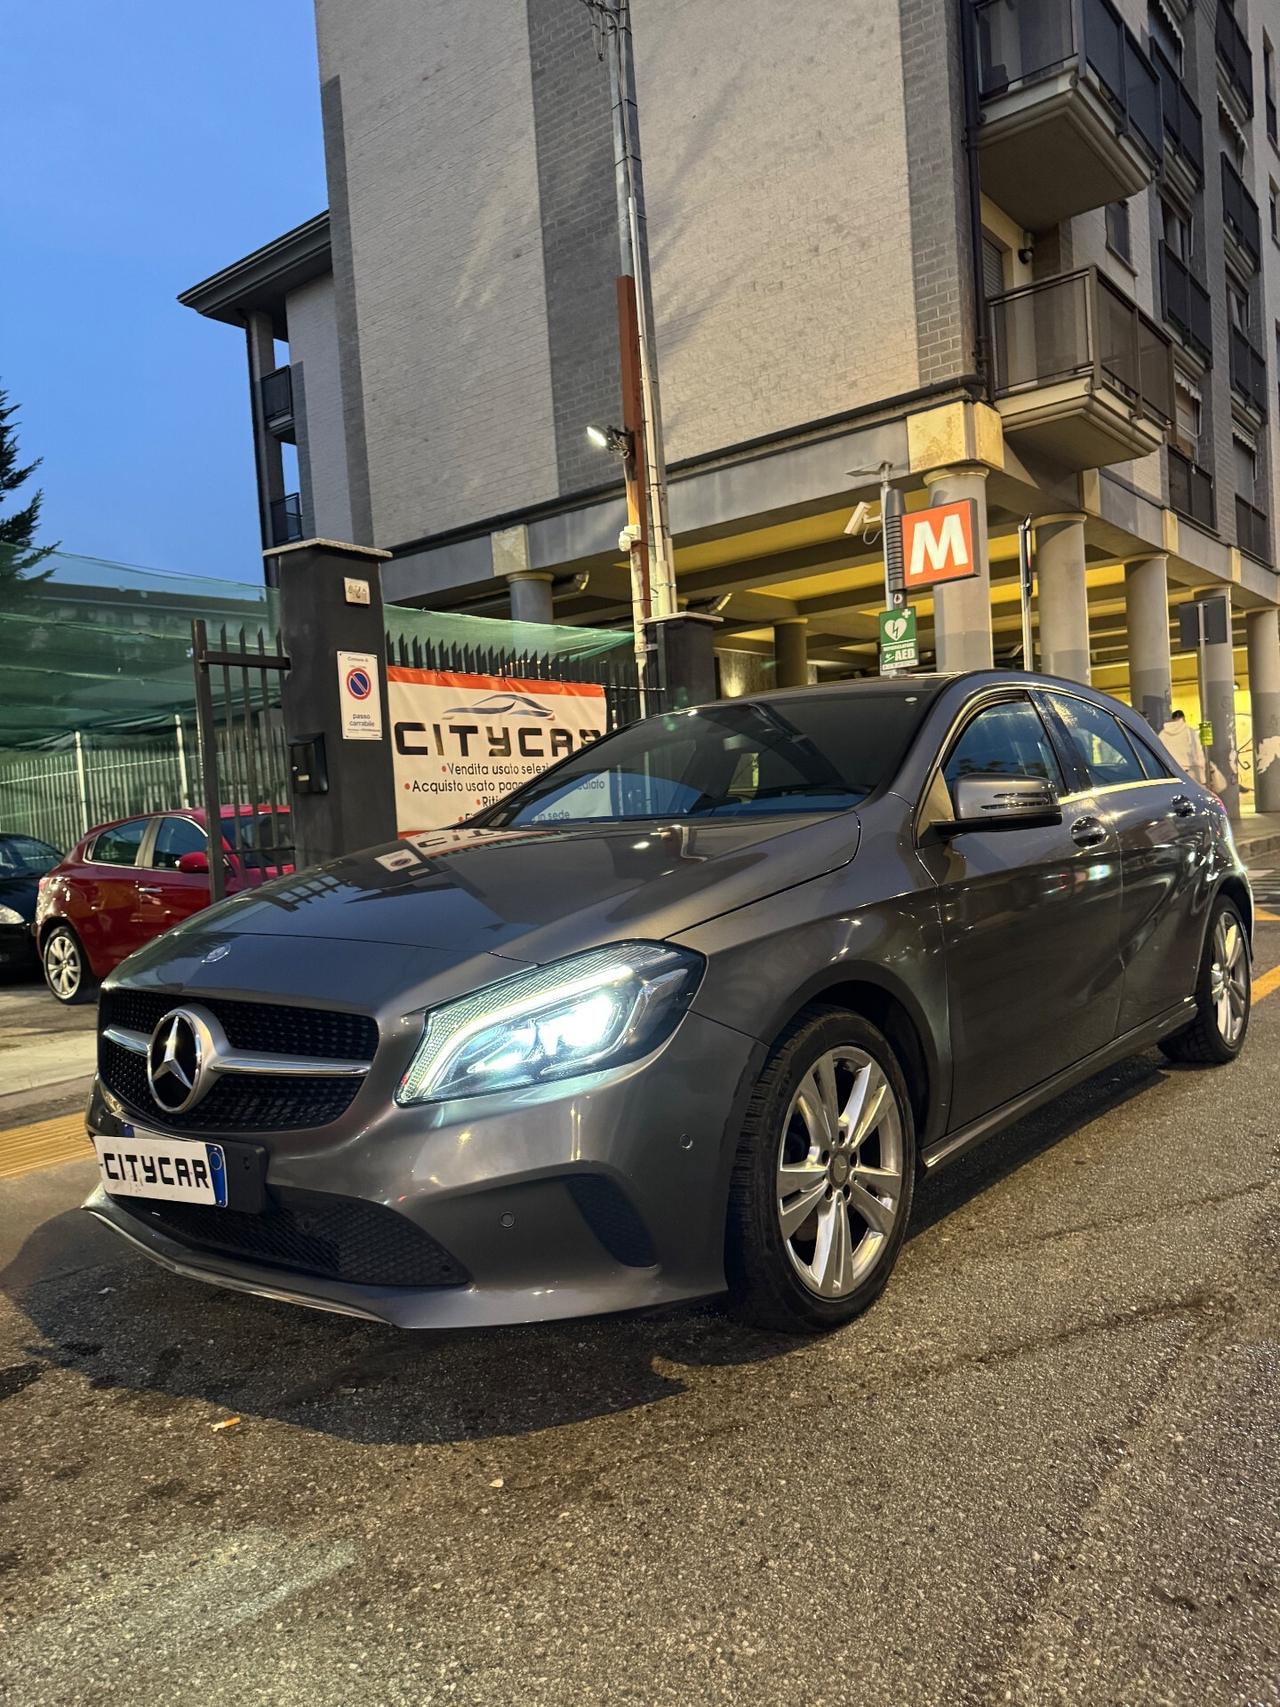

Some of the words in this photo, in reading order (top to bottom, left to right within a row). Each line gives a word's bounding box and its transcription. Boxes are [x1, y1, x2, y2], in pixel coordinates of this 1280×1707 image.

[909, 514, 969, 576] M
[895, 648, 915, 661] AED
[352, 713, 371, 721] passo
[348, 720, 375, 728] carrabile
[394, 721, 601, 757] CITYCAR
[446, 763, 489, 776] Vendita
[492, 764, 519, 775] usato
[412, 780, 463, 794] Acquisto
[465, 780, 496, 792] usato
[547, 809, 570, 820] sede
[103, 1152, 210, 1189] CITYCAR
